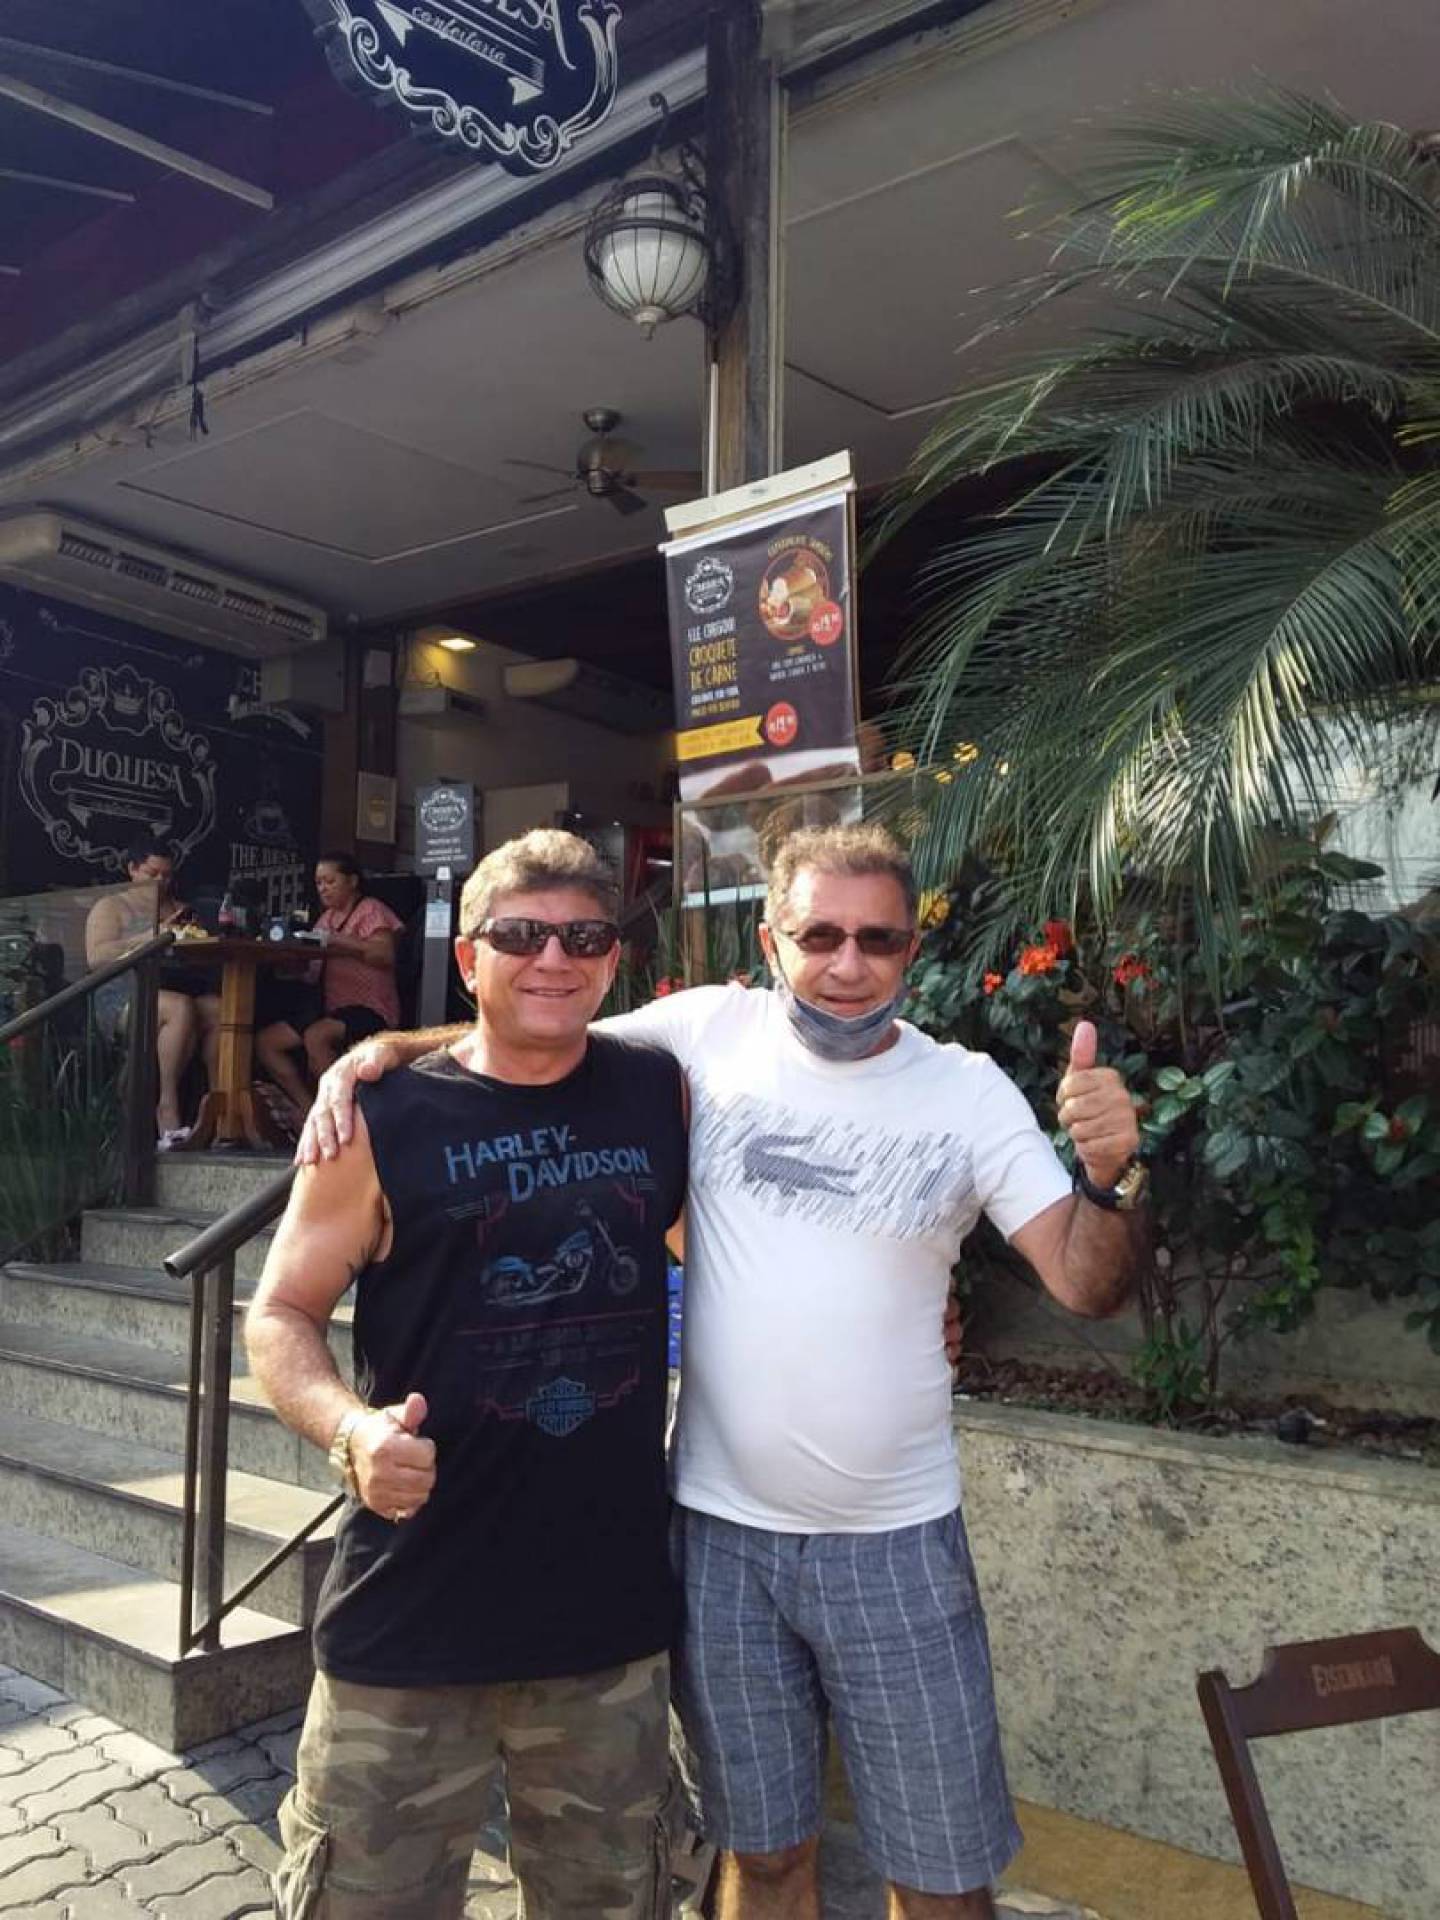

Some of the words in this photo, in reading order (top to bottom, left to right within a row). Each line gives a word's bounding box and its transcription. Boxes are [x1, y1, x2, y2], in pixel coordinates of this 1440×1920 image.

[52, 738, 191, 807] DUQUESA
[444, 1124, 577, 1184] HARLEY-
[507, 1146, 652, 1203] DAVIDSON
